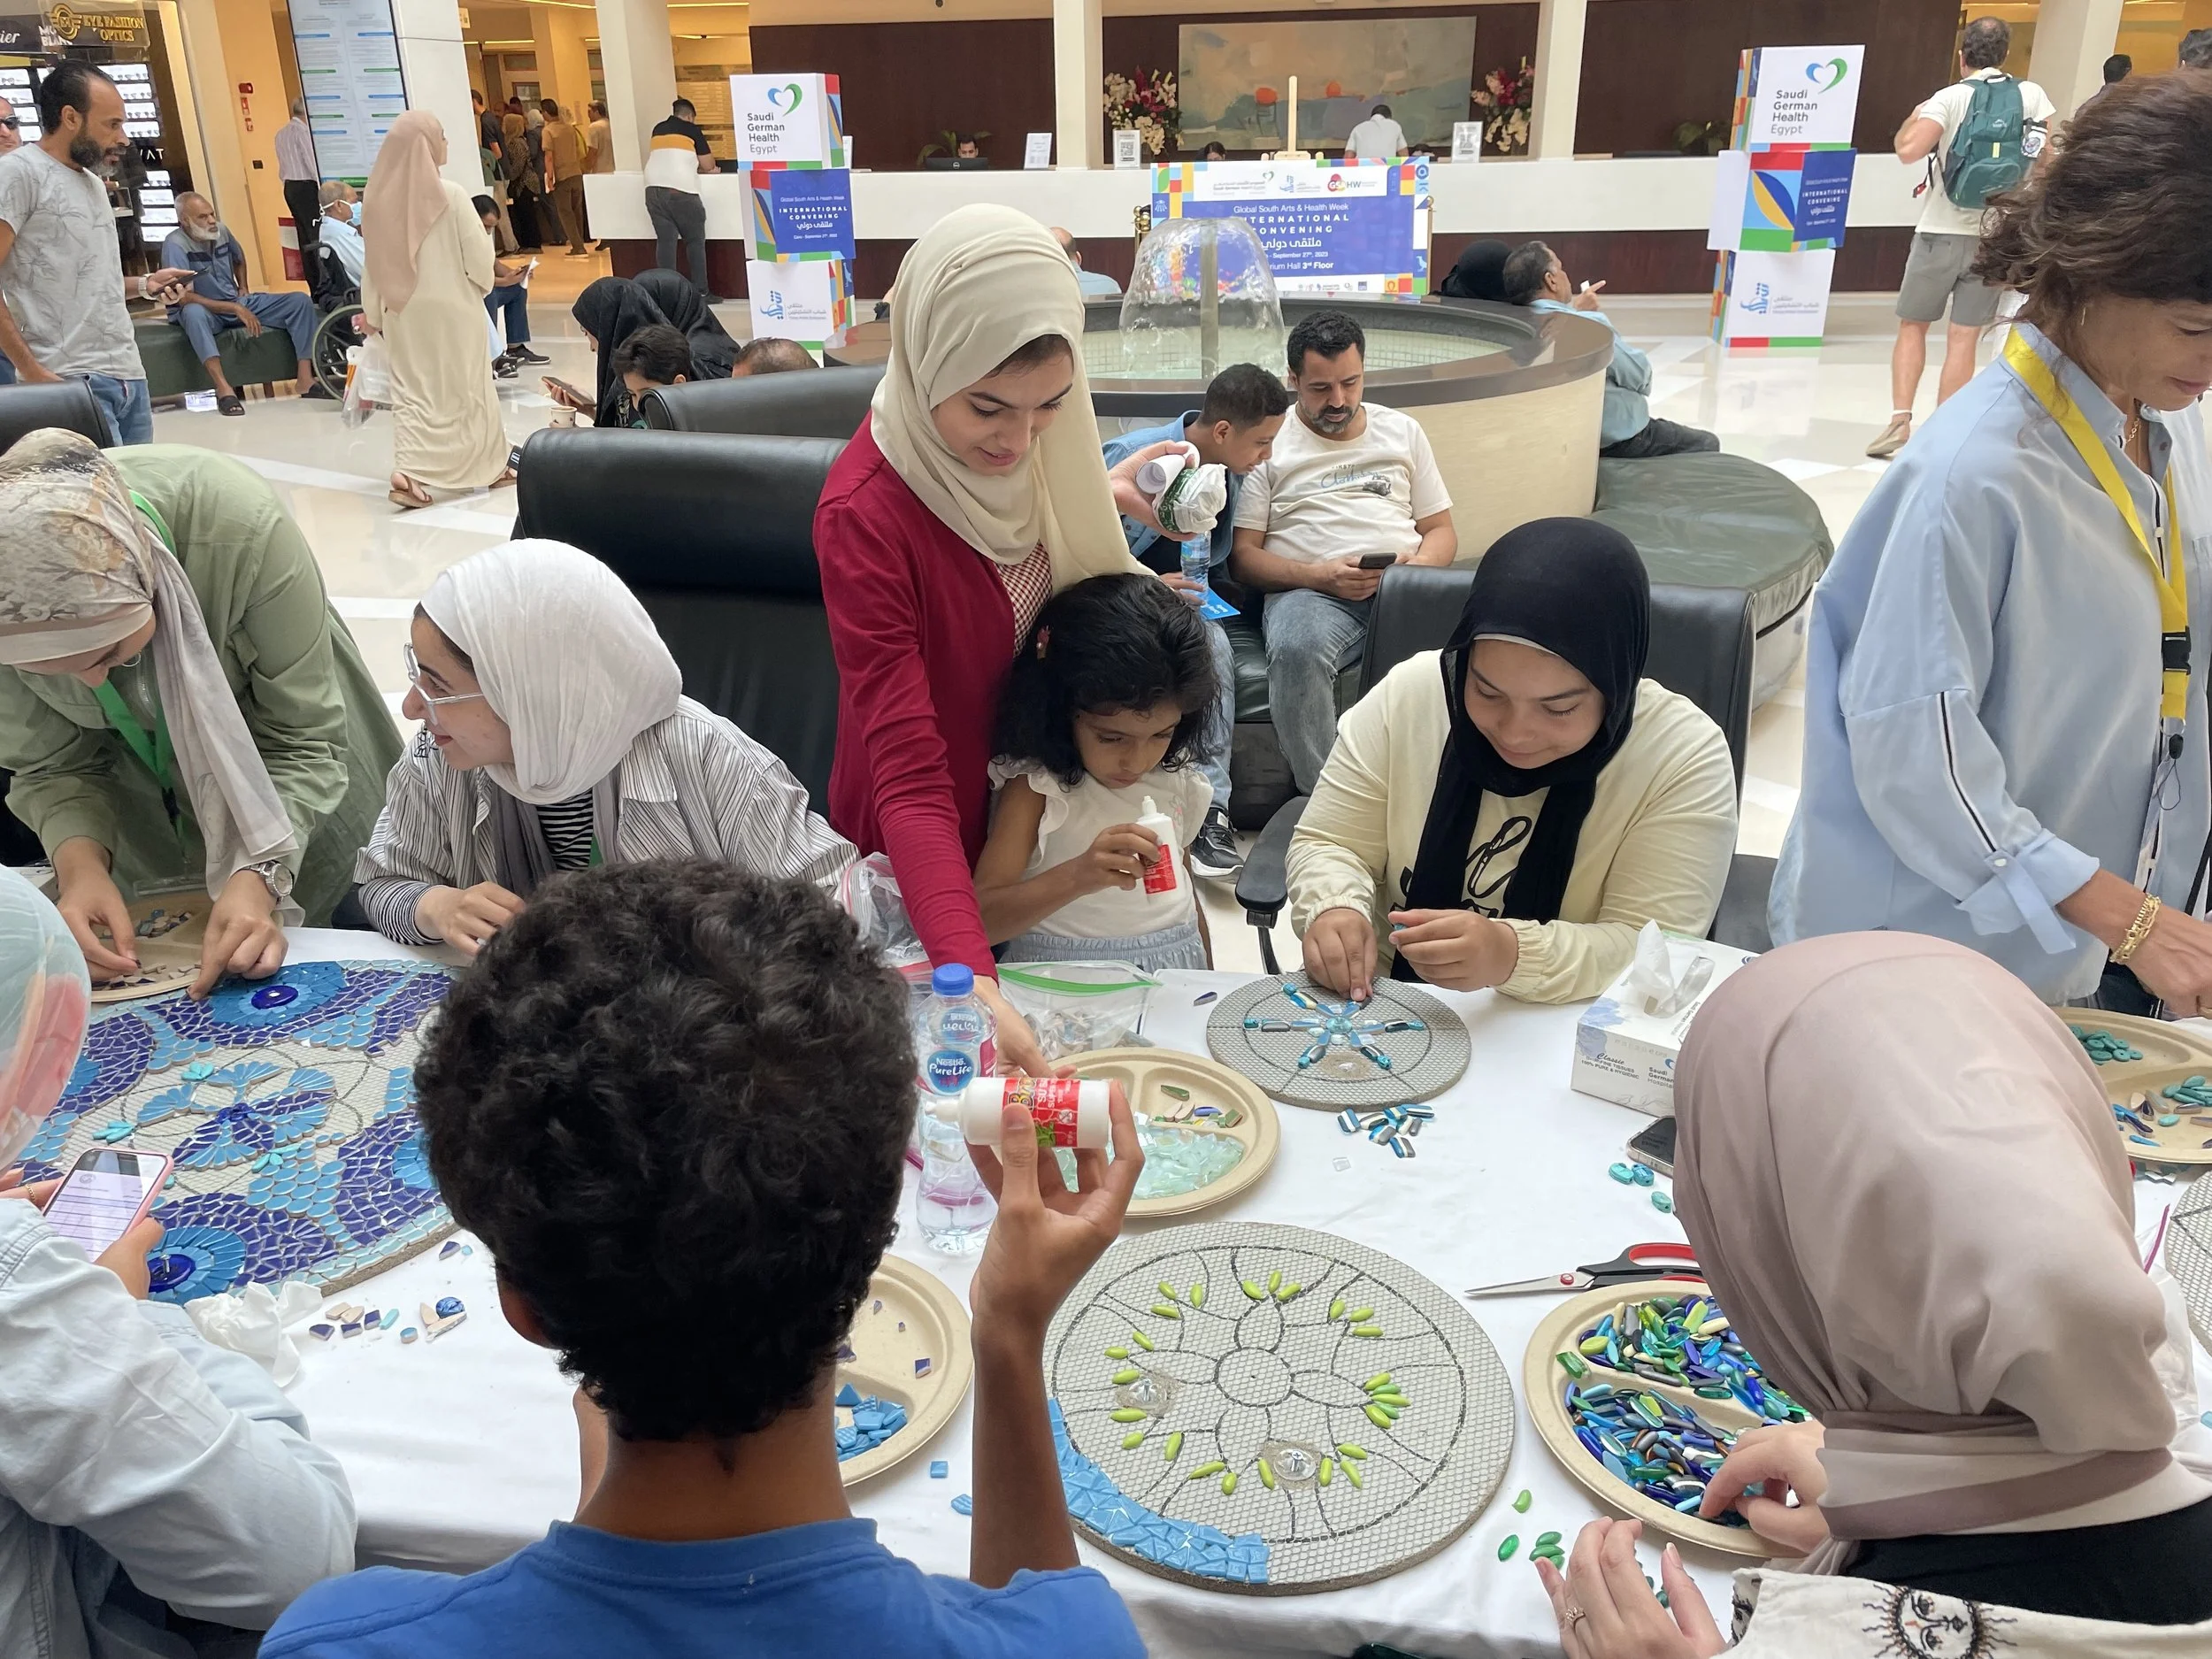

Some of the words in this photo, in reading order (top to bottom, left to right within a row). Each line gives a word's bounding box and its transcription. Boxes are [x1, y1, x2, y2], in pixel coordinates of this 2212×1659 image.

[83, 14, 104, 27] EYE
[103, 15, 144, 29] FASHION
[99, 28, 134, 42] OPTICS
[1776, 89, 1809, 99] Saudi
[1773, 101, 1818, 111] German
[747, 111, 774, 121] Saudi
[1772, 111, 1809, 122] Health
[747, 123, 785, 132] German
[1770, 124, 1803, 136] Egypt
[749, 133, 780, 142] Health
[749, 143, 778, 155] Egypt
[1801, 188, 1847, 197] INTERNATIONAL
[1807, 196, 1840, 205] CONVENING
[1258, 204, 1279, 213] South
[1244, 214, 1349, 224] TERNATIONAL
[1289, 237, 1322, 248] ملتقى
[1596, 1052, 1625, 1066] Classic
[1614, 1069, 1640, 1079] HYGIENIC
[1648, 1066, 1668, 1076] Saudi
[1647, 1078, 1674, 1089] Hospita
